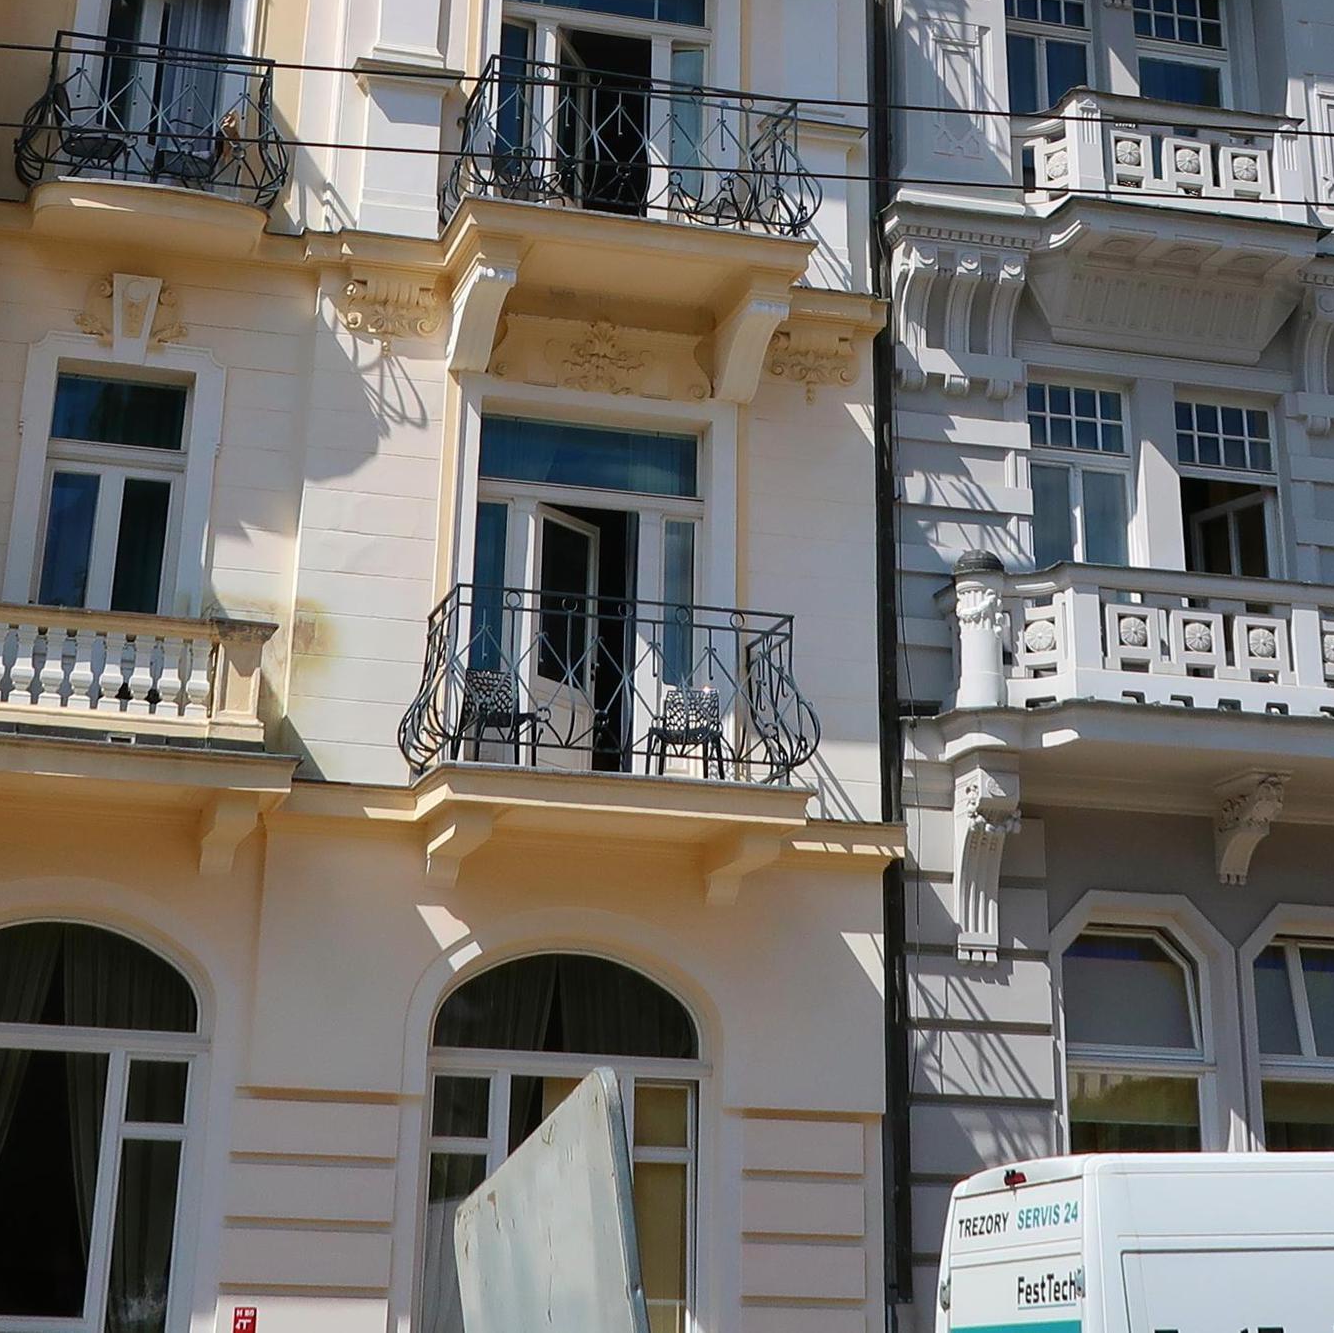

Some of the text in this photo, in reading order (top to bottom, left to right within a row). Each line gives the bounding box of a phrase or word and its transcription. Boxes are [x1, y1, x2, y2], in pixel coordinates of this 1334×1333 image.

[958, 1201, 1079, 1239] TREZORY SERVIS 24
[1017, 1271, 1077, 1305] FestTech
